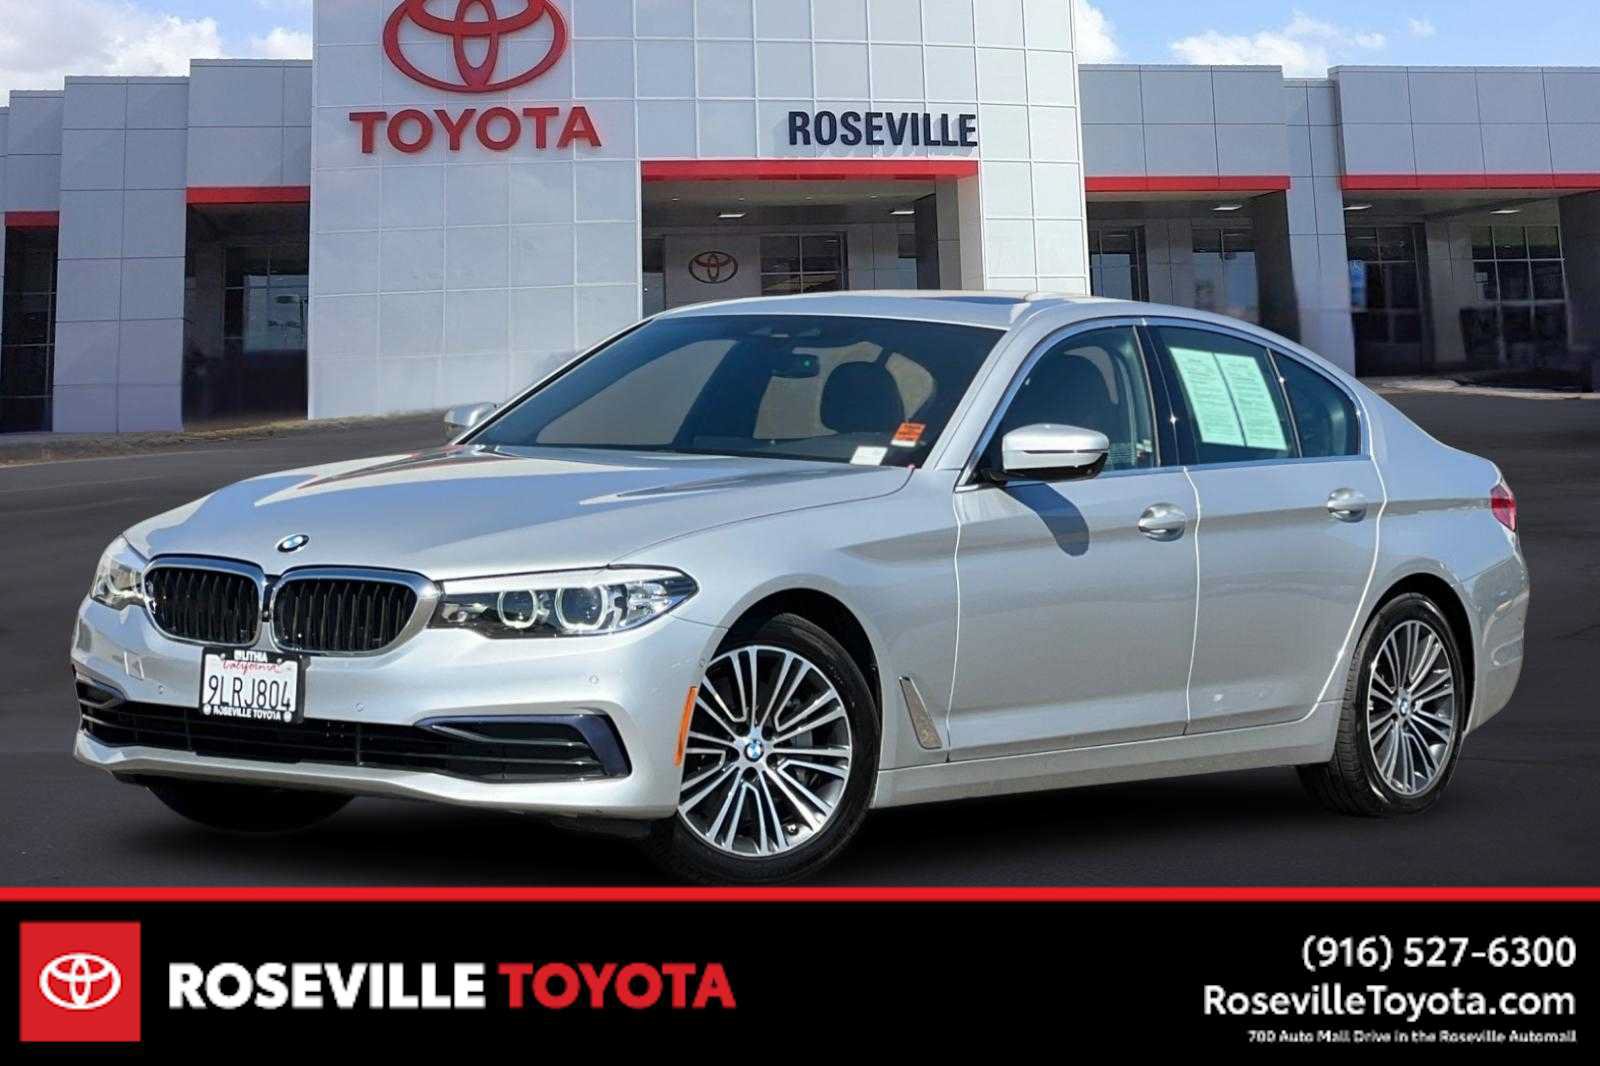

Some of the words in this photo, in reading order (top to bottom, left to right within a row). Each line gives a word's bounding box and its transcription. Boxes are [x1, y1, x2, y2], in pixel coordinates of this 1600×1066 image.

[349, 106, 603, 155] TOYOTA
[788, 110, 979, 147] ROSEVILLE
[208, 674, 291, 709] 9LRJ804
[213, 704, 252, 718] ROSEVILLE
[253, 708, 281, 721] TOYOTA
